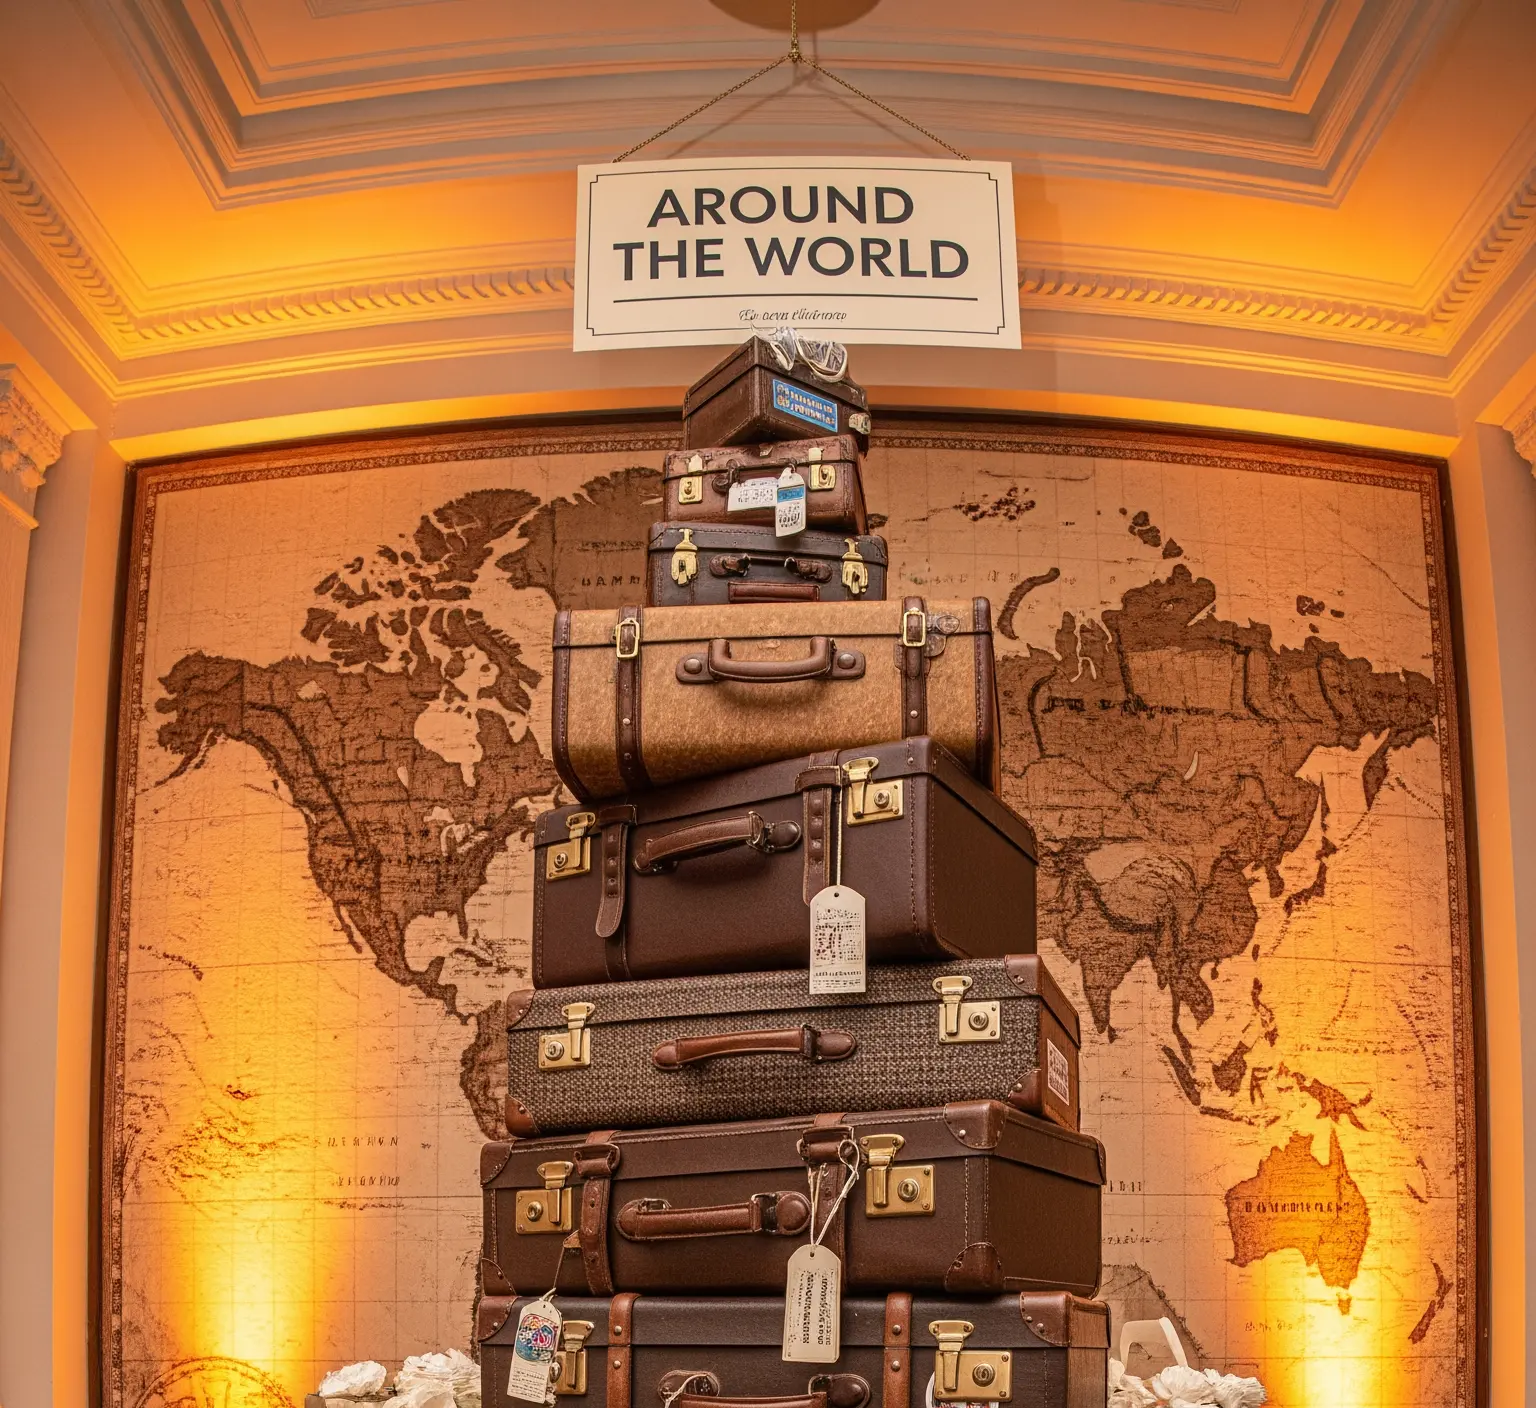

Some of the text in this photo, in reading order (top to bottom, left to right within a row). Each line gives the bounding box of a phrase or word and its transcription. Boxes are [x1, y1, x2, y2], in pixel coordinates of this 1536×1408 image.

[646, 185, 914, 228] AROUND
[612, 236, 969, 281] THE WORLD
